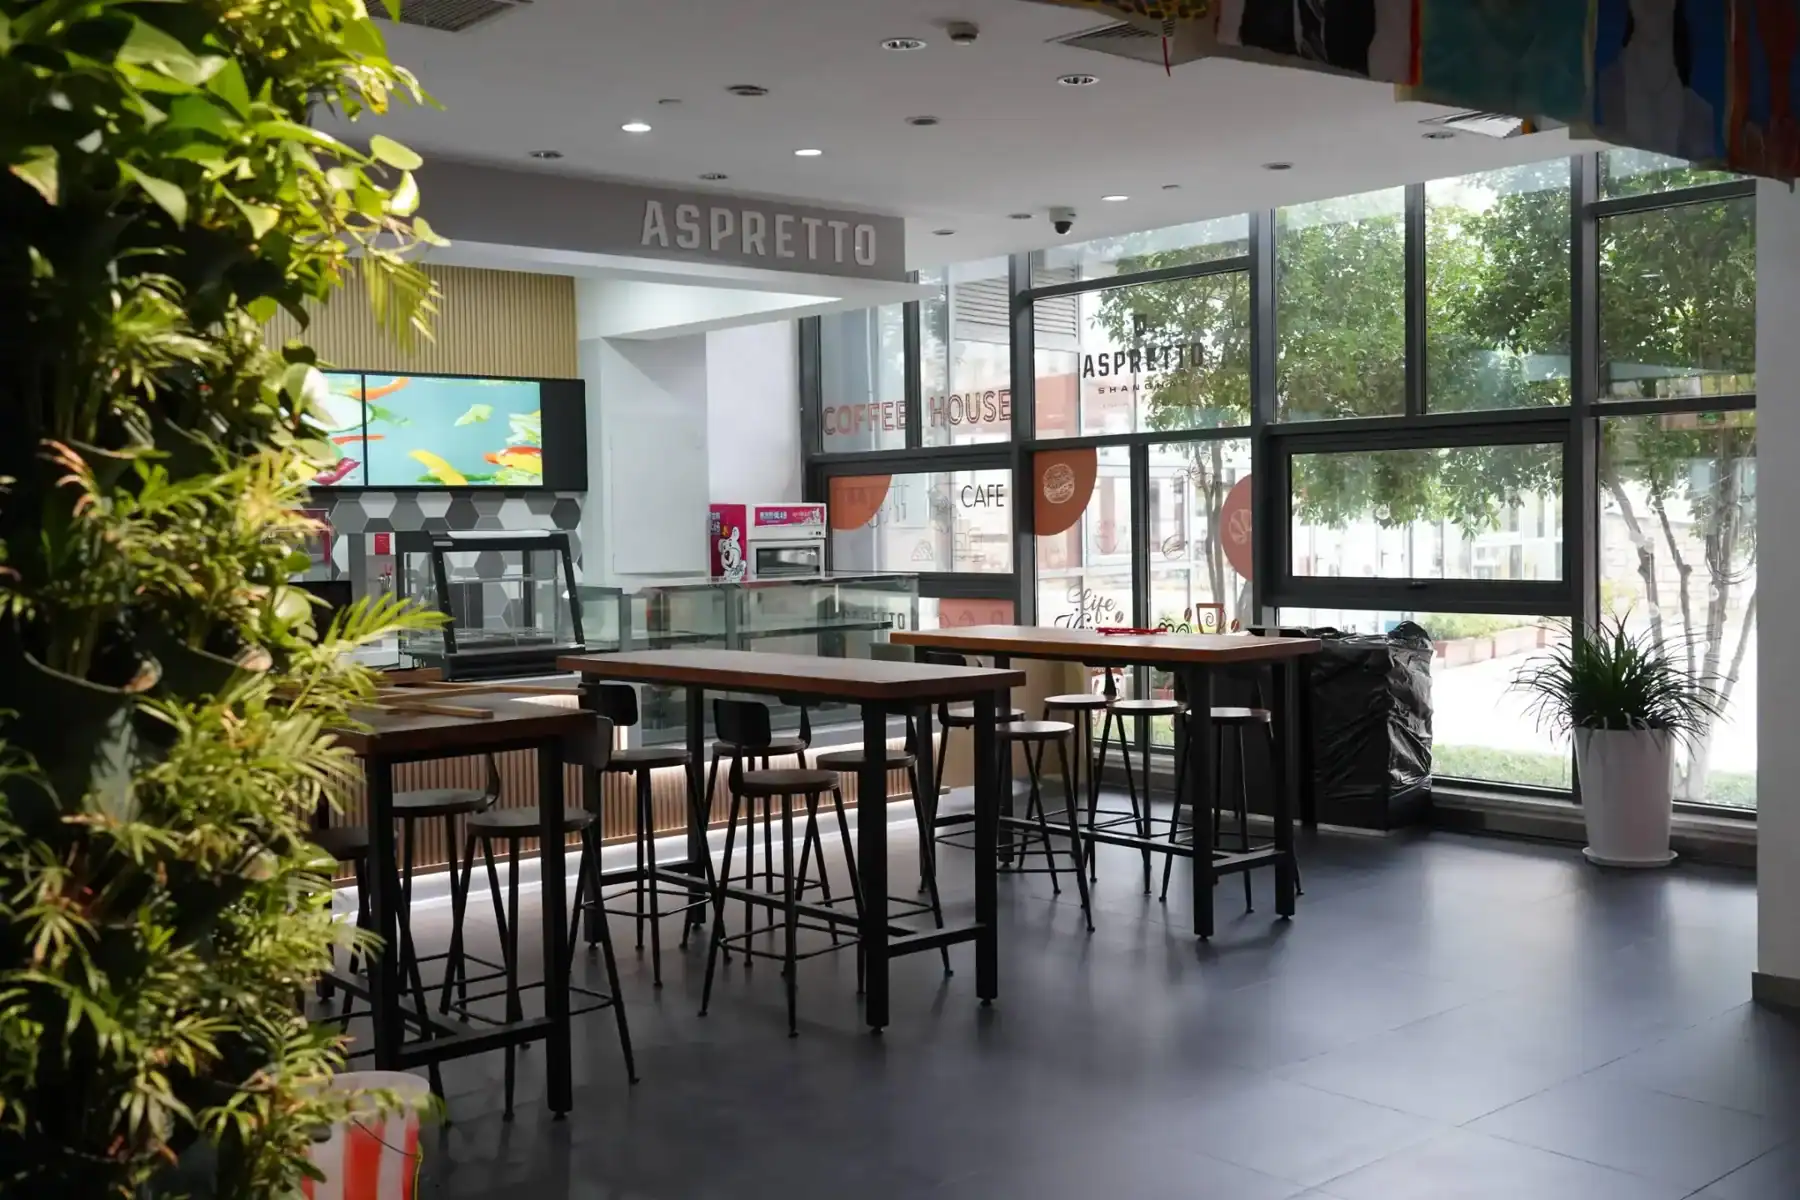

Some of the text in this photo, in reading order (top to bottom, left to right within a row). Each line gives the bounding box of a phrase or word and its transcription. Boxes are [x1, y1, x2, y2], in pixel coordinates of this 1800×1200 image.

[641, 199, 876, 266] ASPRETTO
[1082, 341, 1204, 379] ASPRETTO
[823, 388, 1012, 435] COFFEE HOUSE
[961, 483, 1005, 509] CAFE
